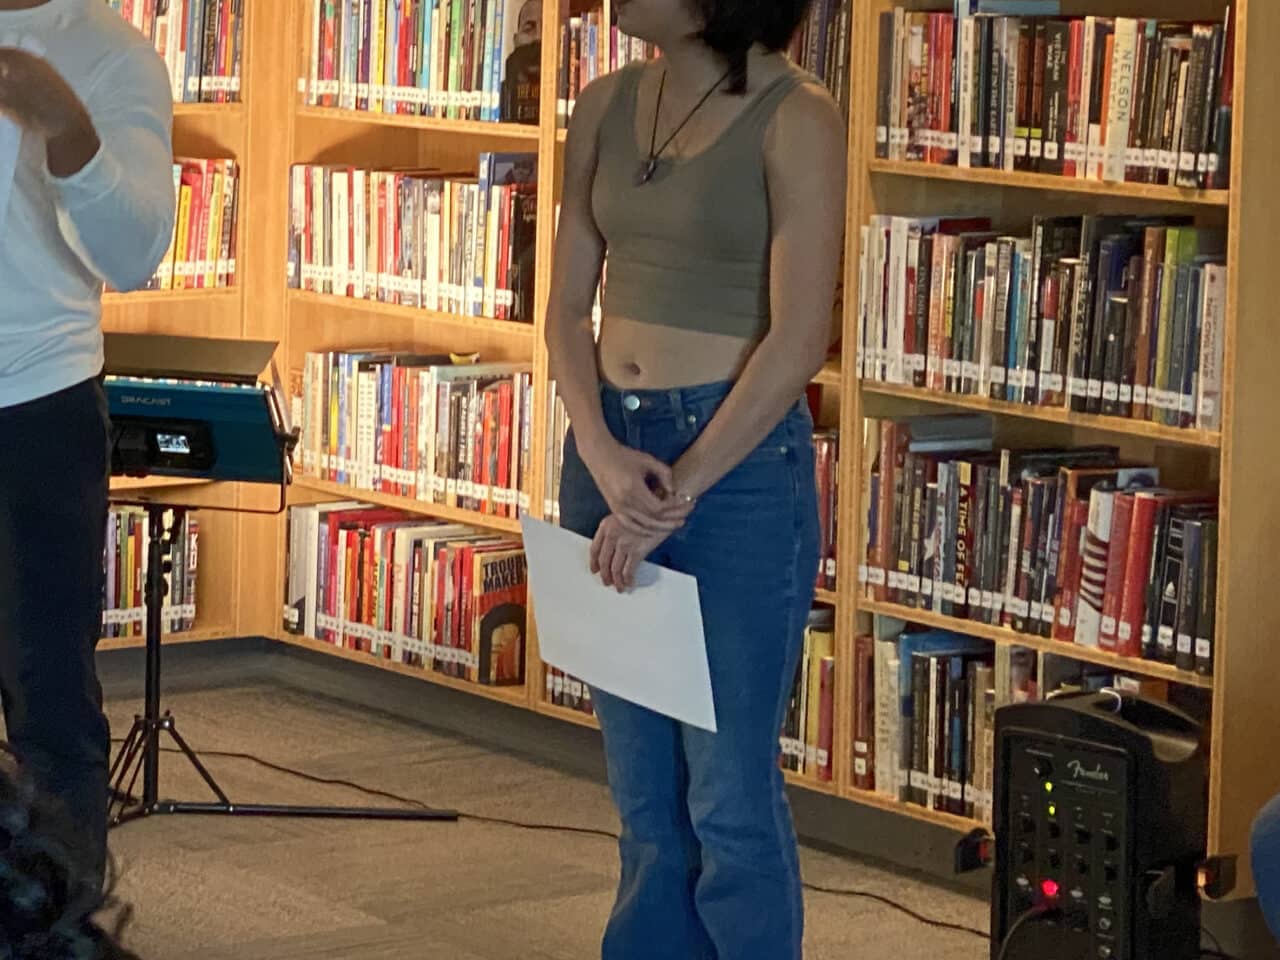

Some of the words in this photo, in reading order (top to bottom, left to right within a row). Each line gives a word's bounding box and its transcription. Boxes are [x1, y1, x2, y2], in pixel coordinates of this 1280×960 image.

[1117, 48, 1133, 121] NELSON
[959, 486, 969, 498] A
[958, 501, 969, 536] TIME
[956, 539, 967, 562] OF
[1066, 759, 1109, 781] Fender
